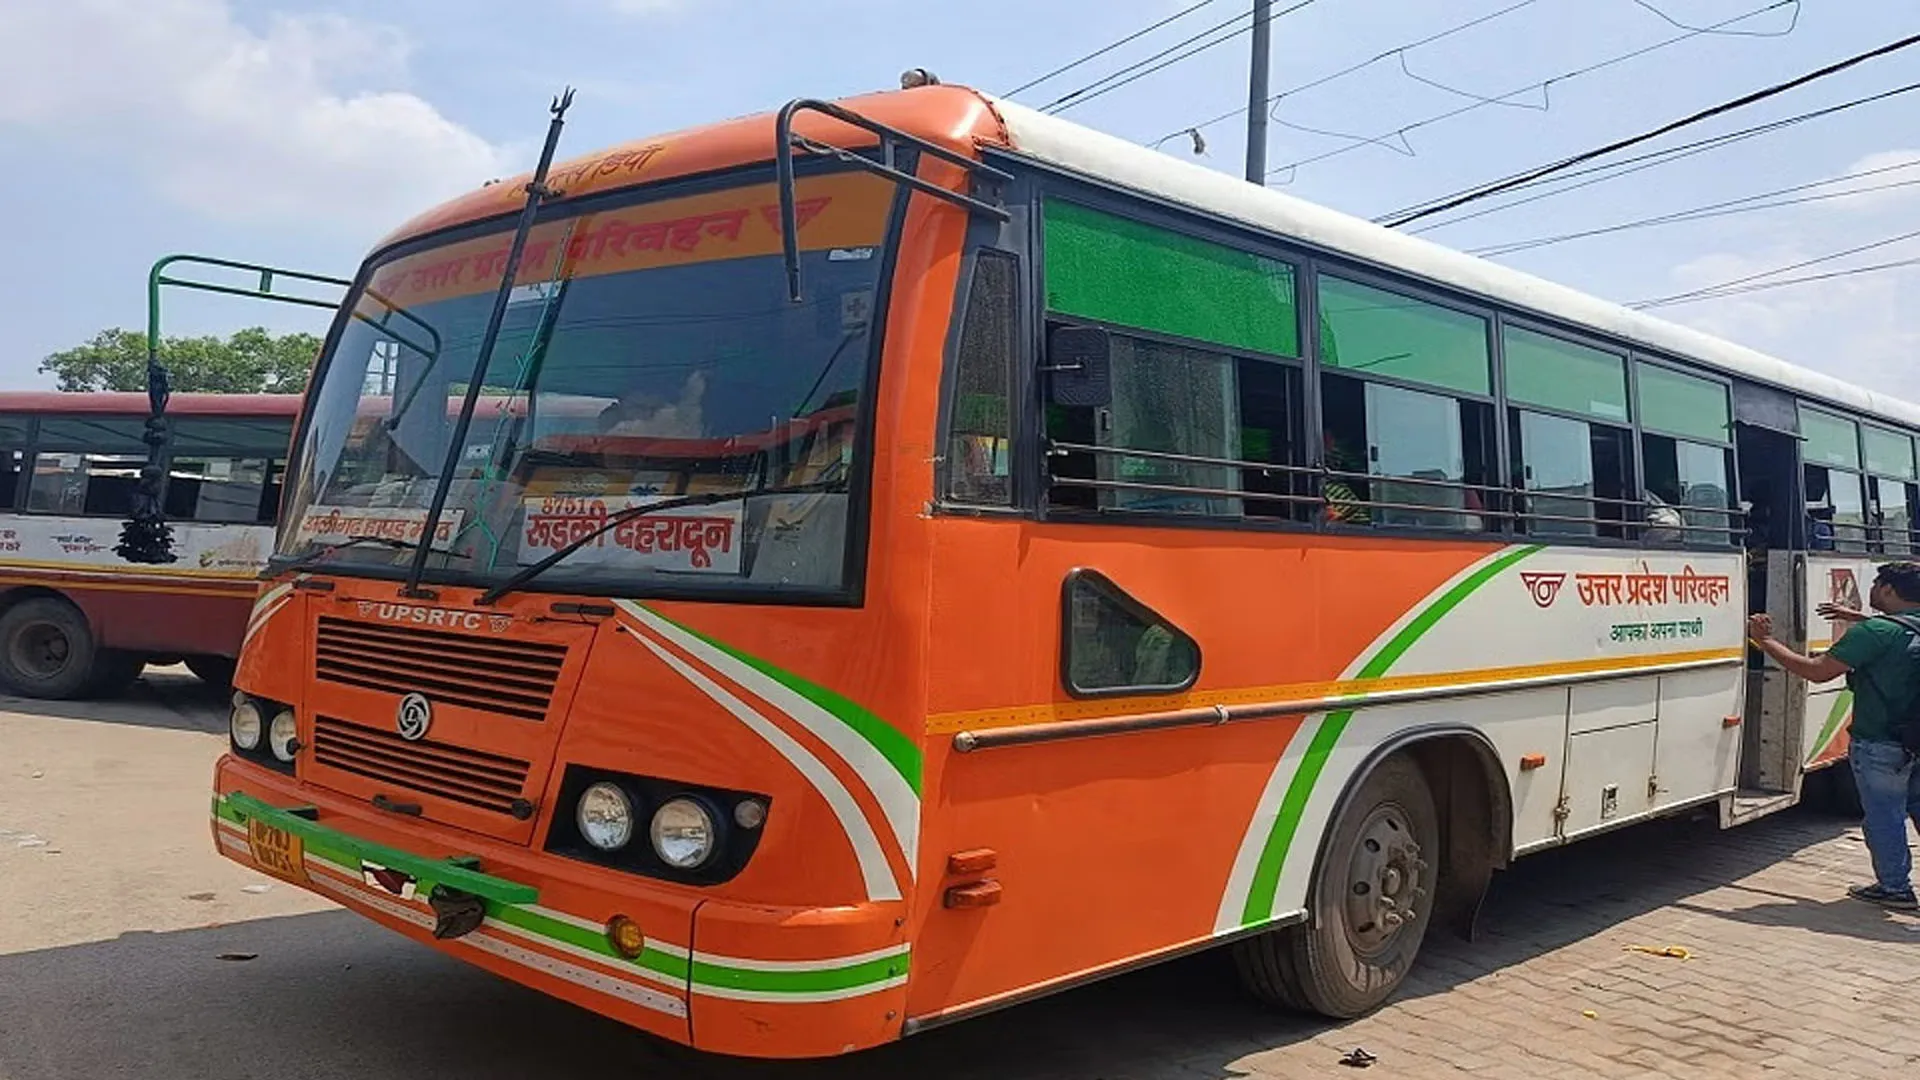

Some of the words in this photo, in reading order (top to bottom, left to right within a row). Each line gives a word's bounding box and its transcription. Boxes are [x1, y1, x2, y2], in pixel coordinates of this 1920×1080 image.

[563, 209, 750, 261] परिवहन
[1575, 573, 1622, 606] उत्तर
[1626, 560, 1668, 606] प्रदेश
[1670, 564, 1729, 607] परिवहन
[378, 603, 483, 629] UPSRTC
[1609, 622, 1648, 642] आपका
[1650, 621, 1676, 641] अपना
[1678, 617, 1703, 638] साथी
